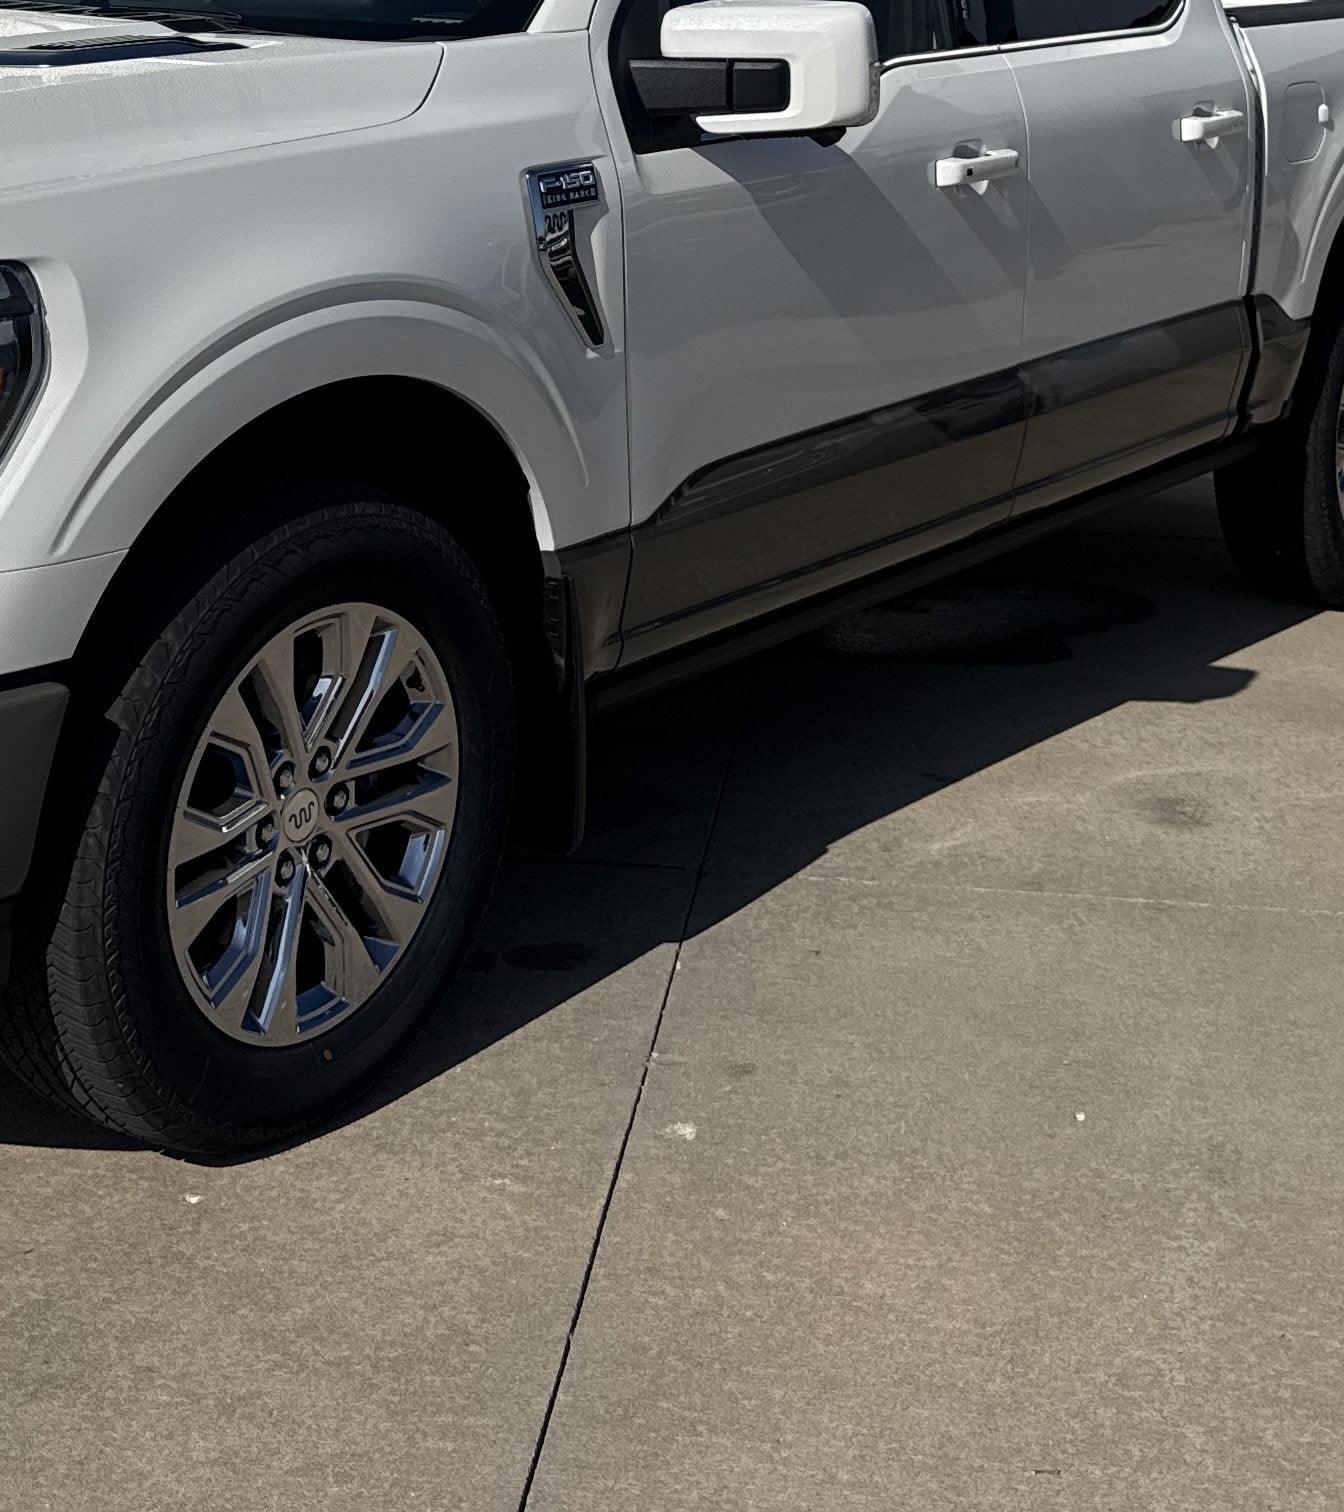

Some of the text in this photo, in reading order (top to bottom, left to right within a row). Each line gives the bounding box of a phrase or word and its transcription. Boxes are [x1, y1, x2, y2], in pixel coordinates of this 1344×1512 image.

[539, 170, 596, 193] F-150
[546, 187, 596, 204] KING RANCH
